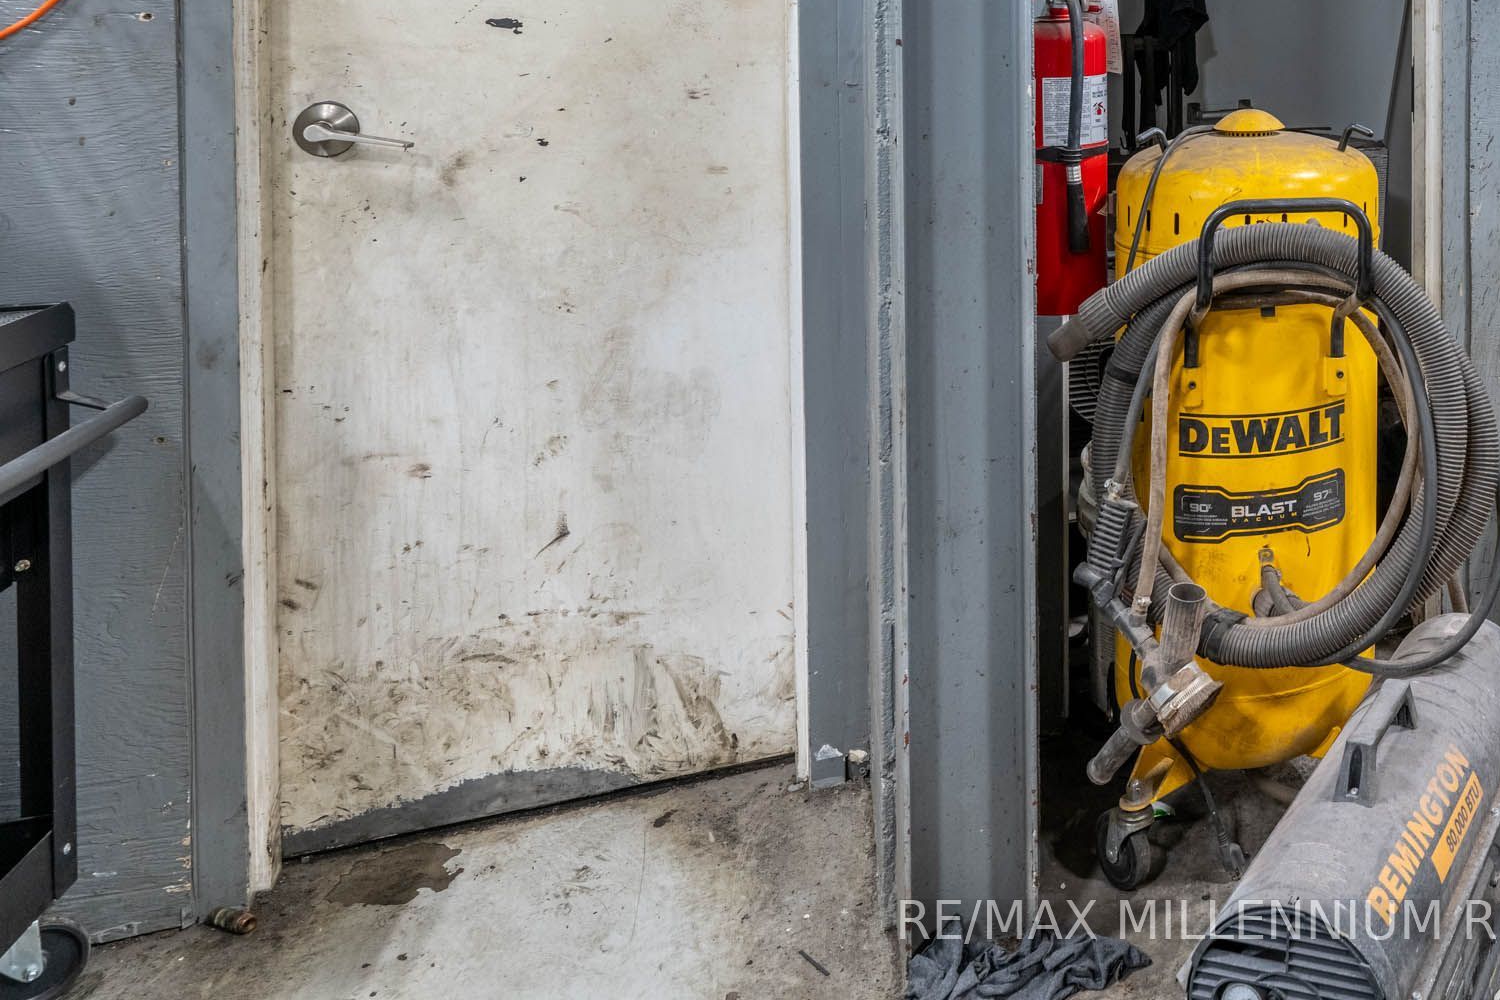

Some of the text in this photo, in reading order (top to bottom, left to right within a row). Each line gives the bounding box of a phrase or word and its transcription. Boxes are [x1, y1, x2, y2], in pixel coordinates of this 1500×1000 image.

[1179, 404, 1345, 454] DEWALT
[1231, 499, 1297, 518] BLAST
[1231, 511, 1298, 523] VACUUM
[1465, 781, 1480, 813] BTU
[1365, 744, 1470, 926] REMINGTON
